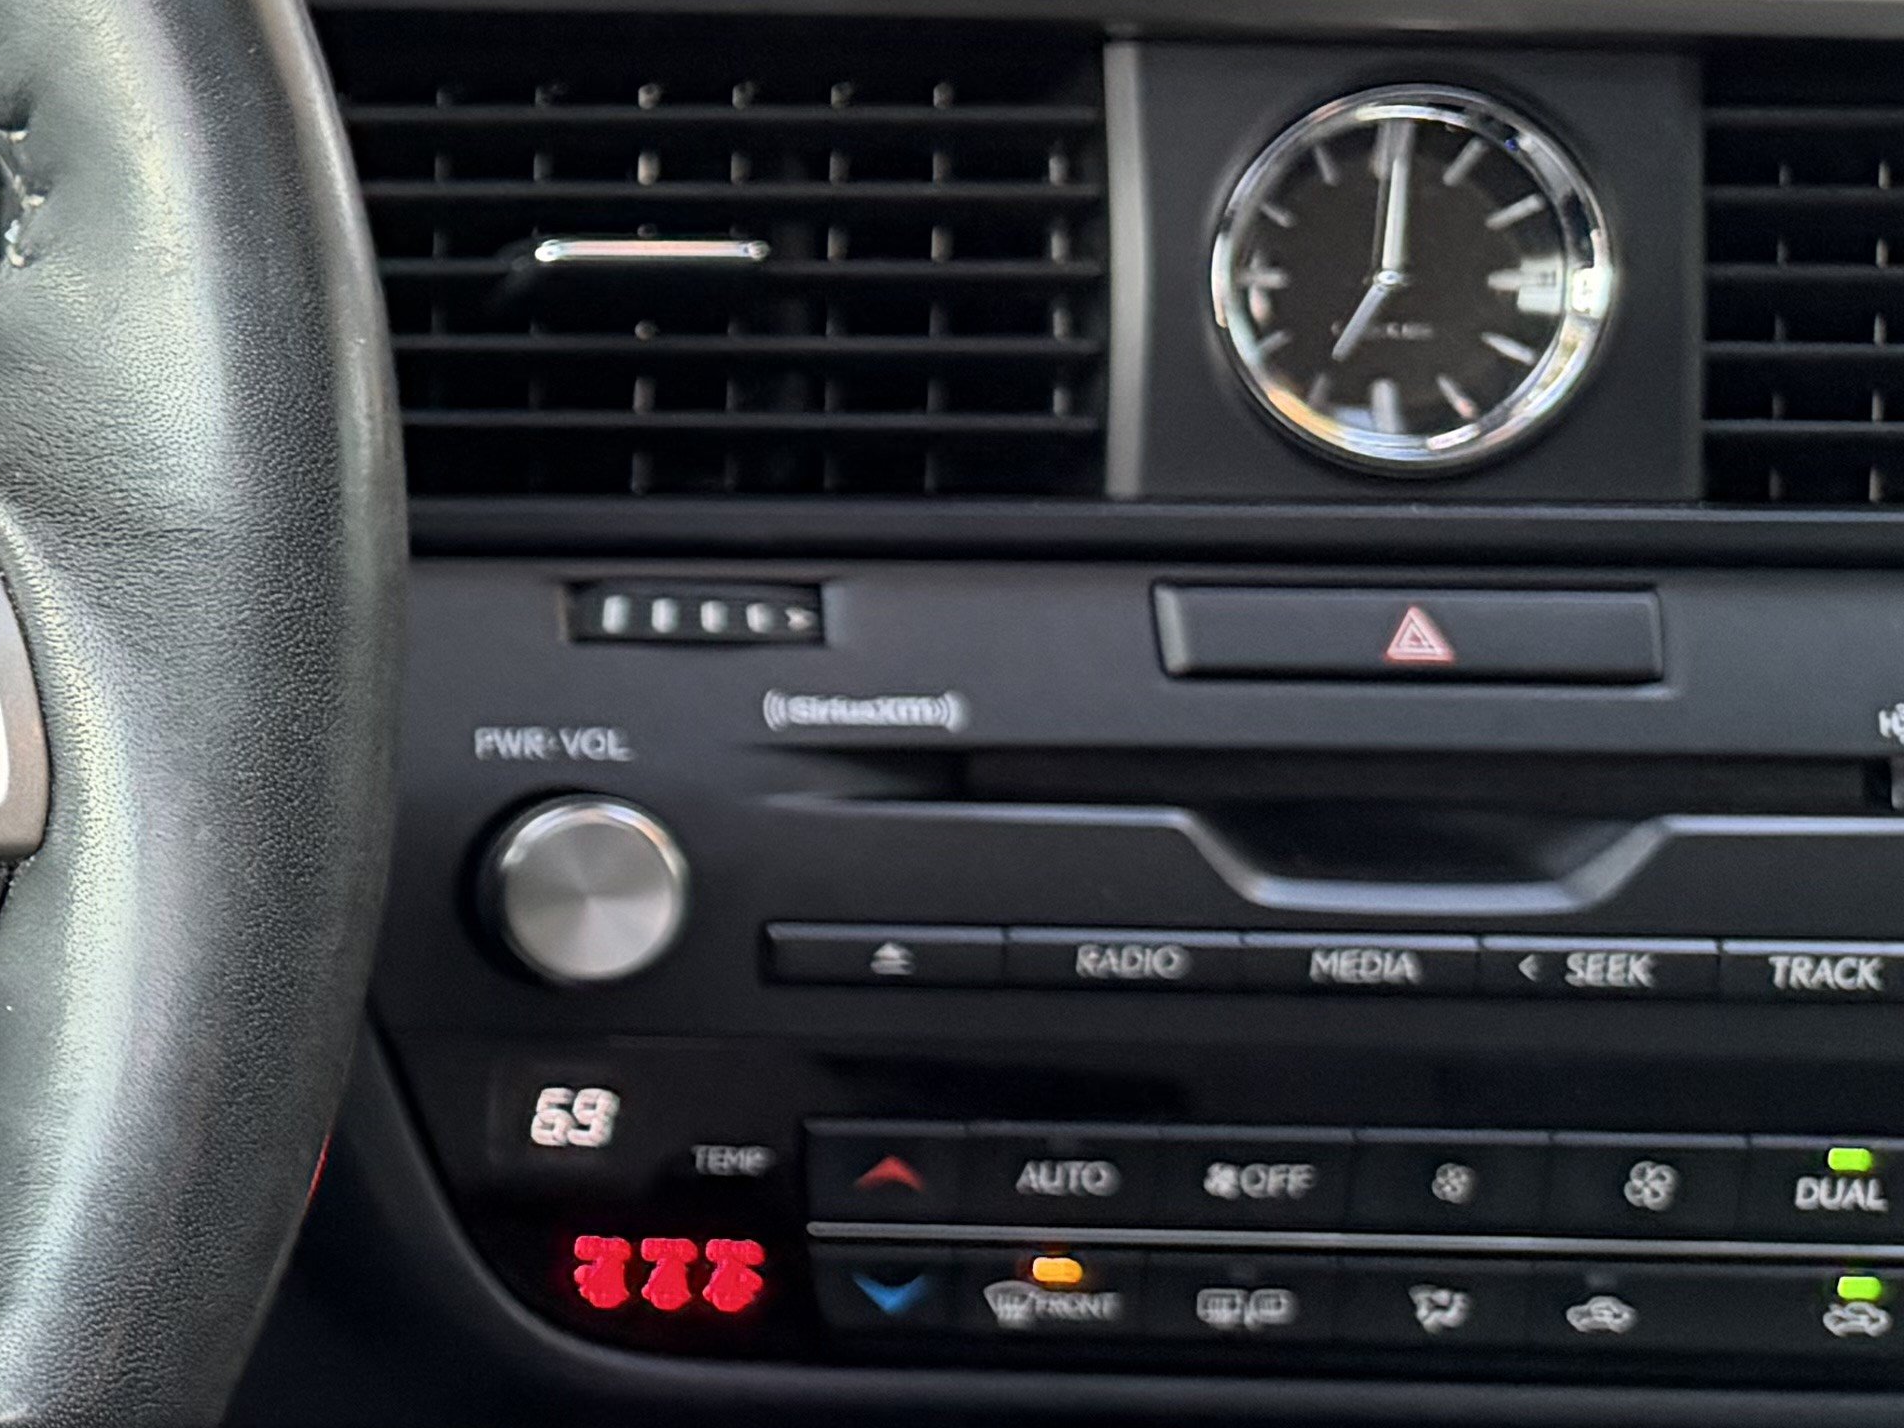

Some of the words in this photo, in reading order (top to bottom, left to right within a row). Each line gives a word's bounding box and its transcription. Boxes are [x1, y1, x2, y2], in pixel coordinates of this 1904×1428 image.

[1076, 944, 1190, 980] RADIO
[1310, 949, 1422, 985] MEDIA
[1565, 954, 1655, 988] SEEK
[1769, 956, 1885, 991] TRACK
[531, 1087, 620, 1148] 69
[694, 1146, 772, 1174] TEMP
[1017, 1161, 1118, 1196] AUTO
[1241, 1164, 1316, 1198] OFF
[1795, 1178, 1887, 1211] DUAL
